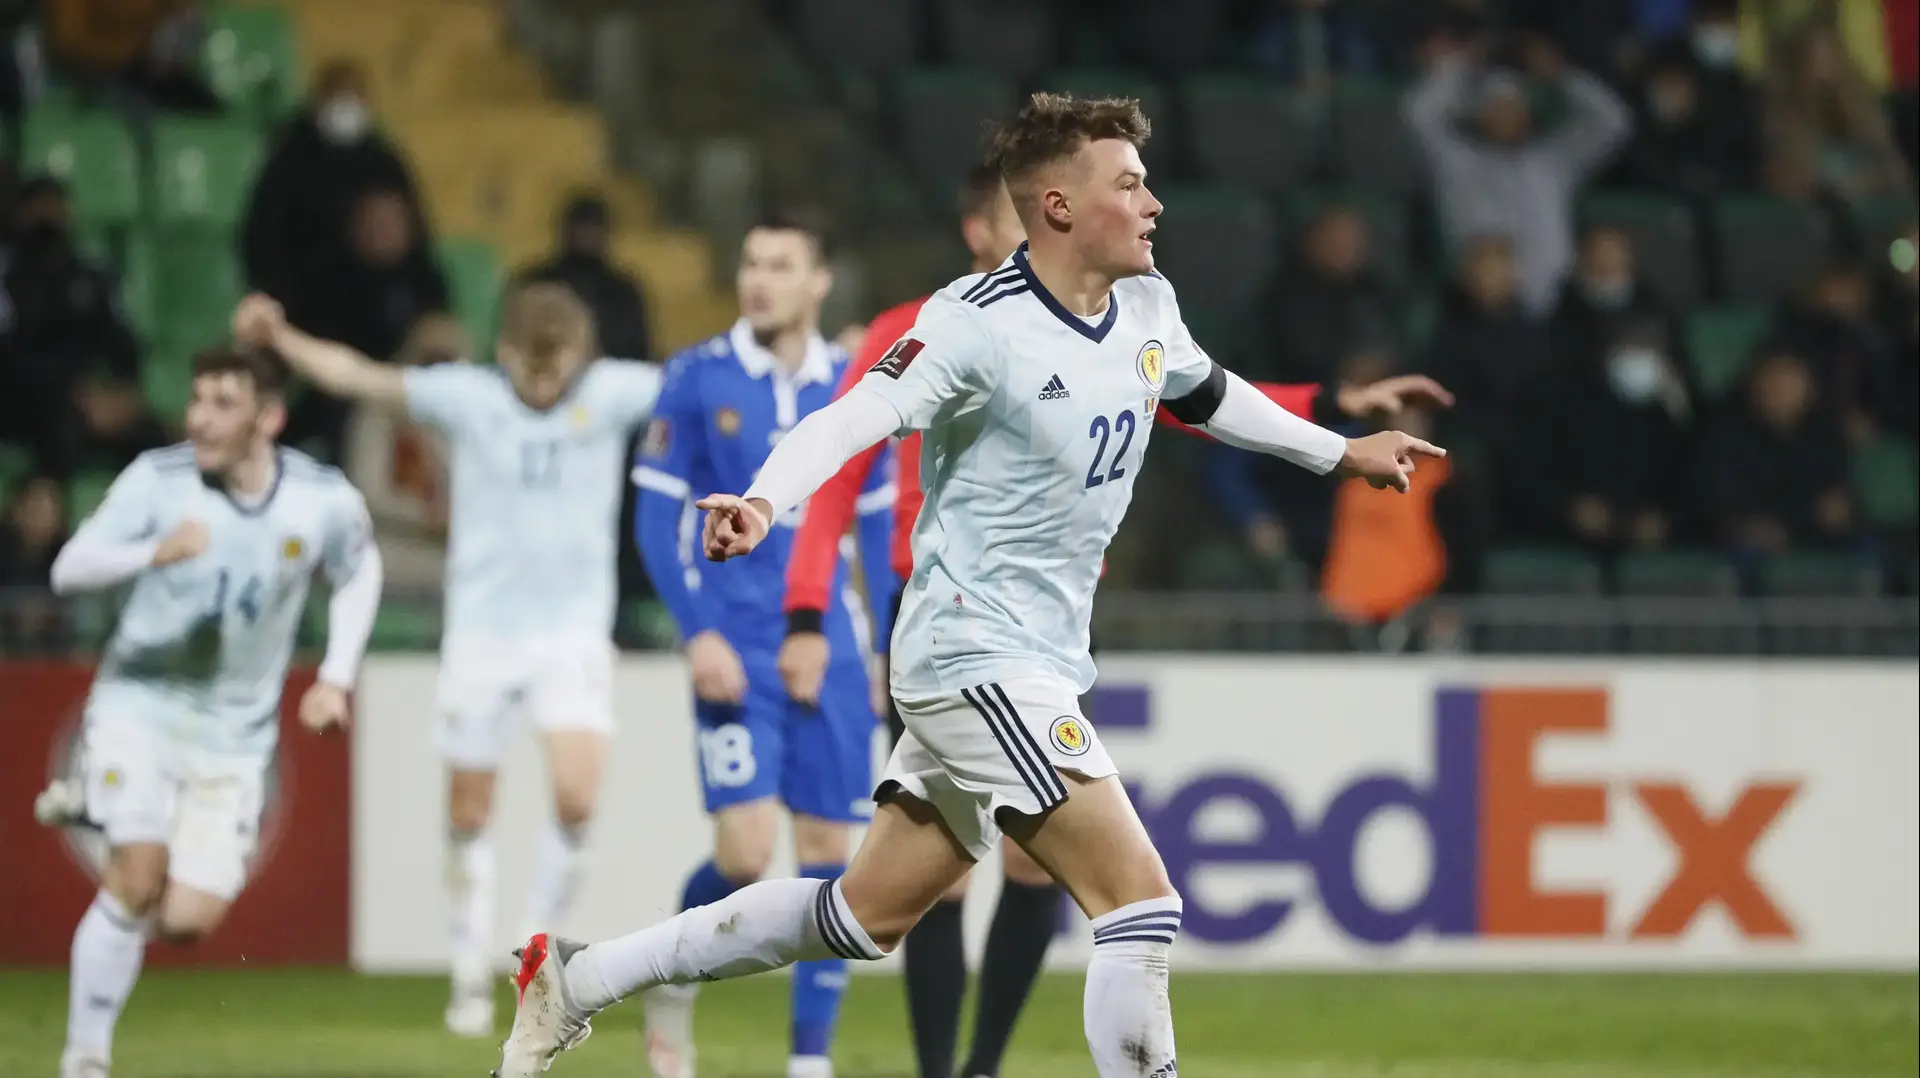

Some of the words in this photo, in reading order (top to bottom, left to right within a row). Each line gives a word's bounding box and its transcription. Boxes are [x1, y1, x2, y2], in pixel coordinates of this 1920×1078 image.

[1038, 389, 1070, 401] adidas
[1085, 409, 1136, 489] 22
[214, 568, 262, 624] 14
[700, 723, 756, 788] 18
